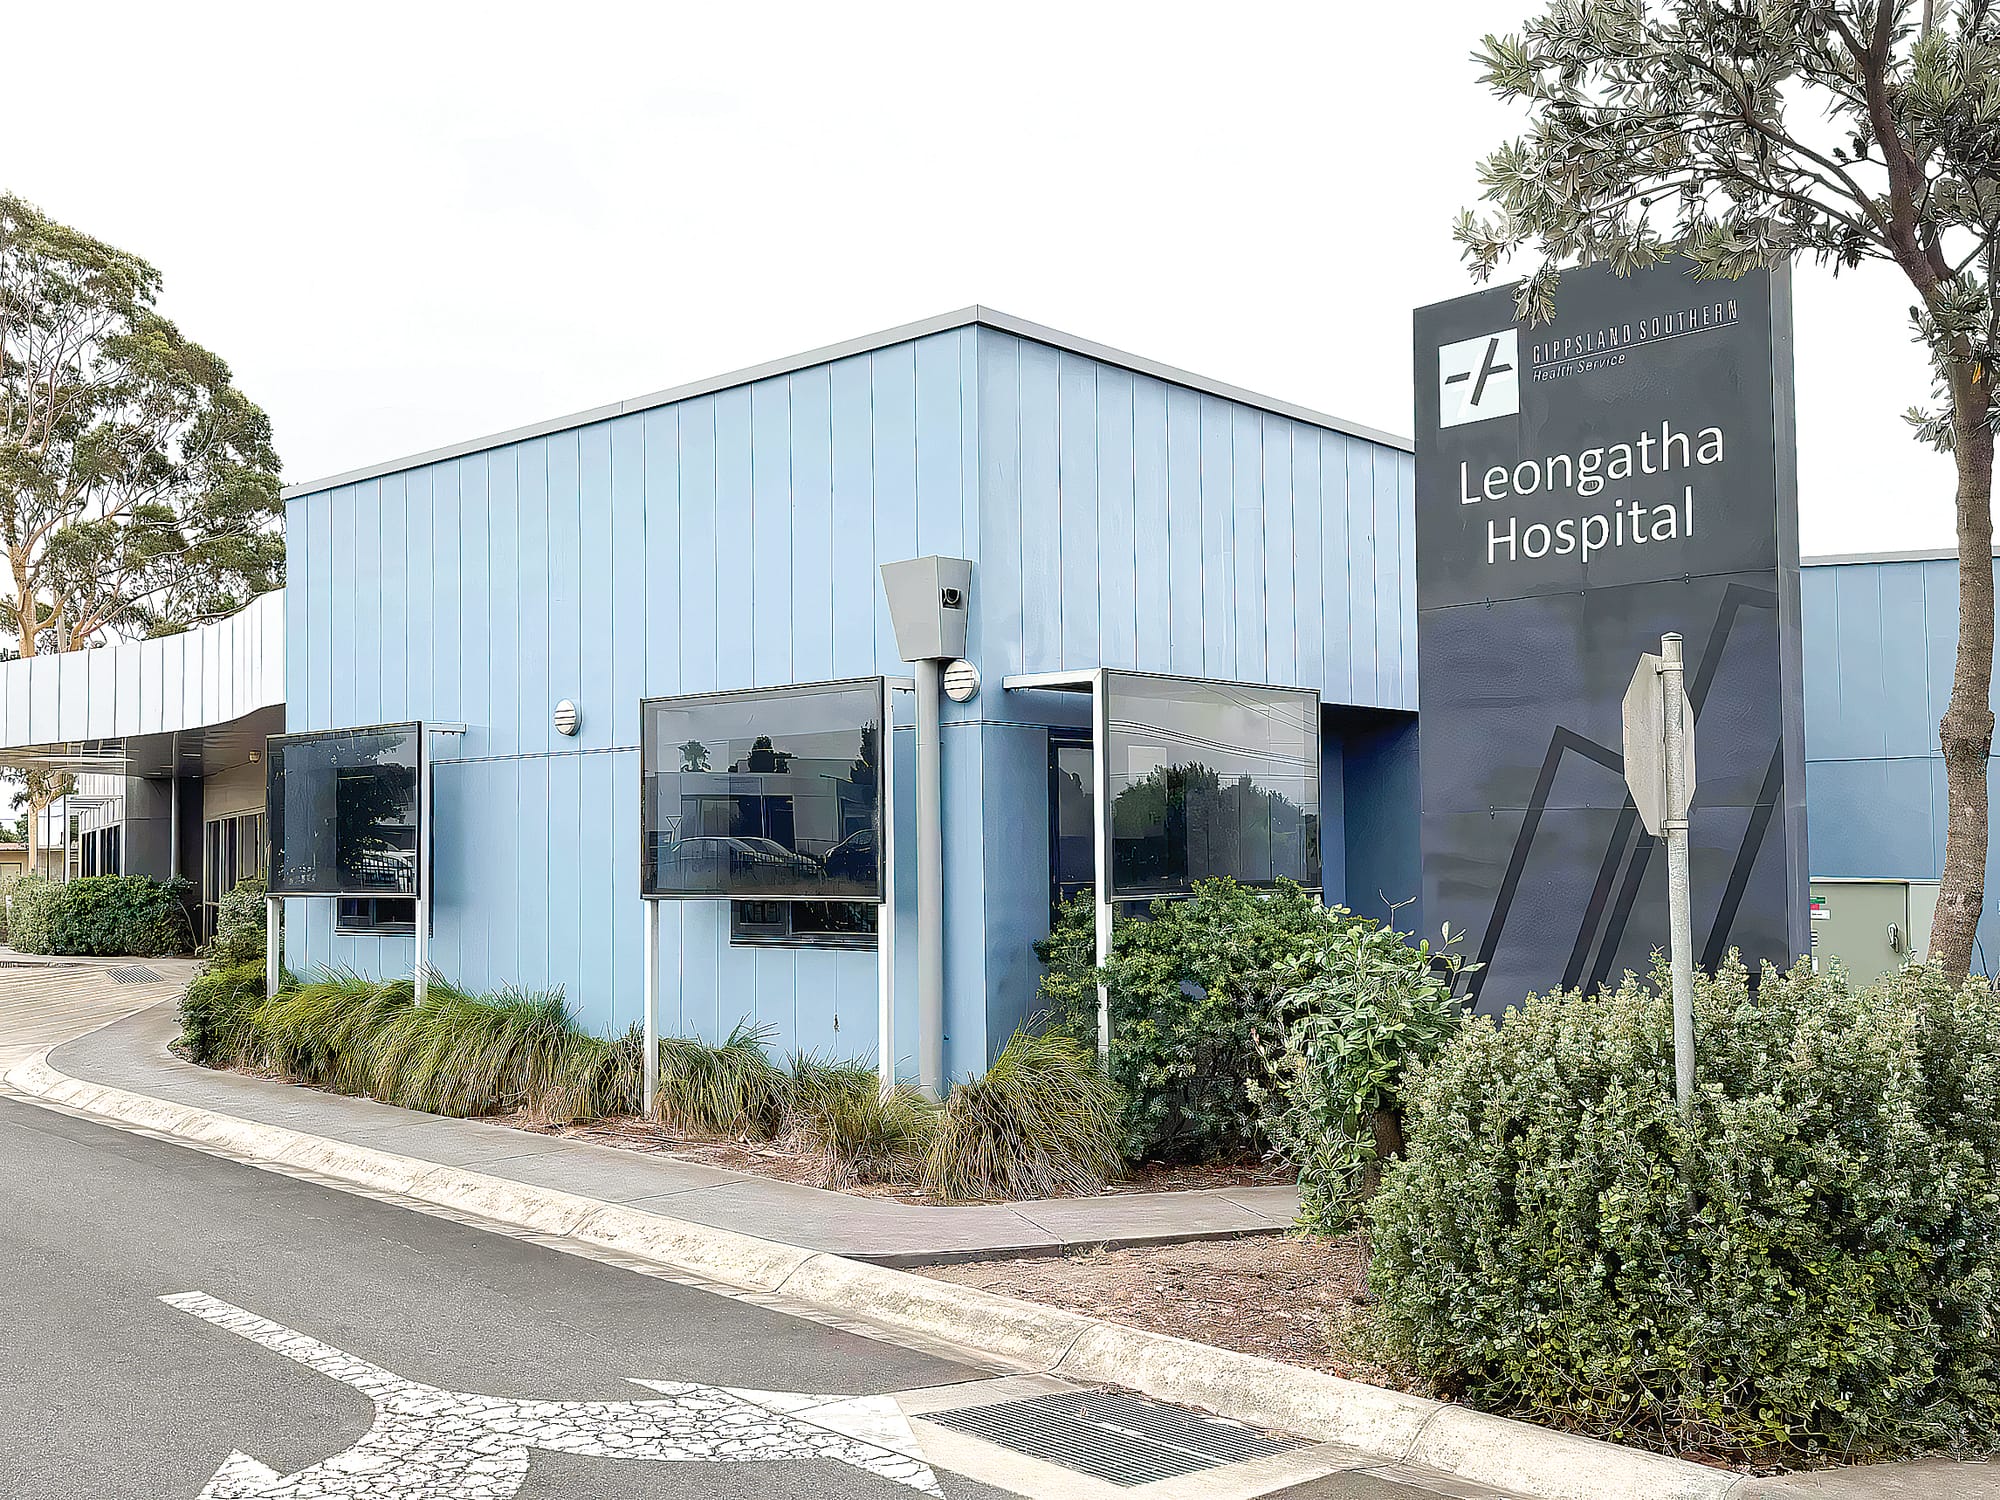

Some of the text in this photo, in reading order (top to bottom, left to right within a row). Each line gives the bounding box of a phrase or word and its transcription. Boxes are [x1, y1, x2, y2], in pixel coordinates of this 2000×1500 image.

[1533, 299, 1738, 364] GIPPSLAND SOUTHERN
[1533, 353, 1626, 382] Health Service
[1460, 420, 1725, 505] Leongatha
[1487, 486, 1694, 564] Hospital
